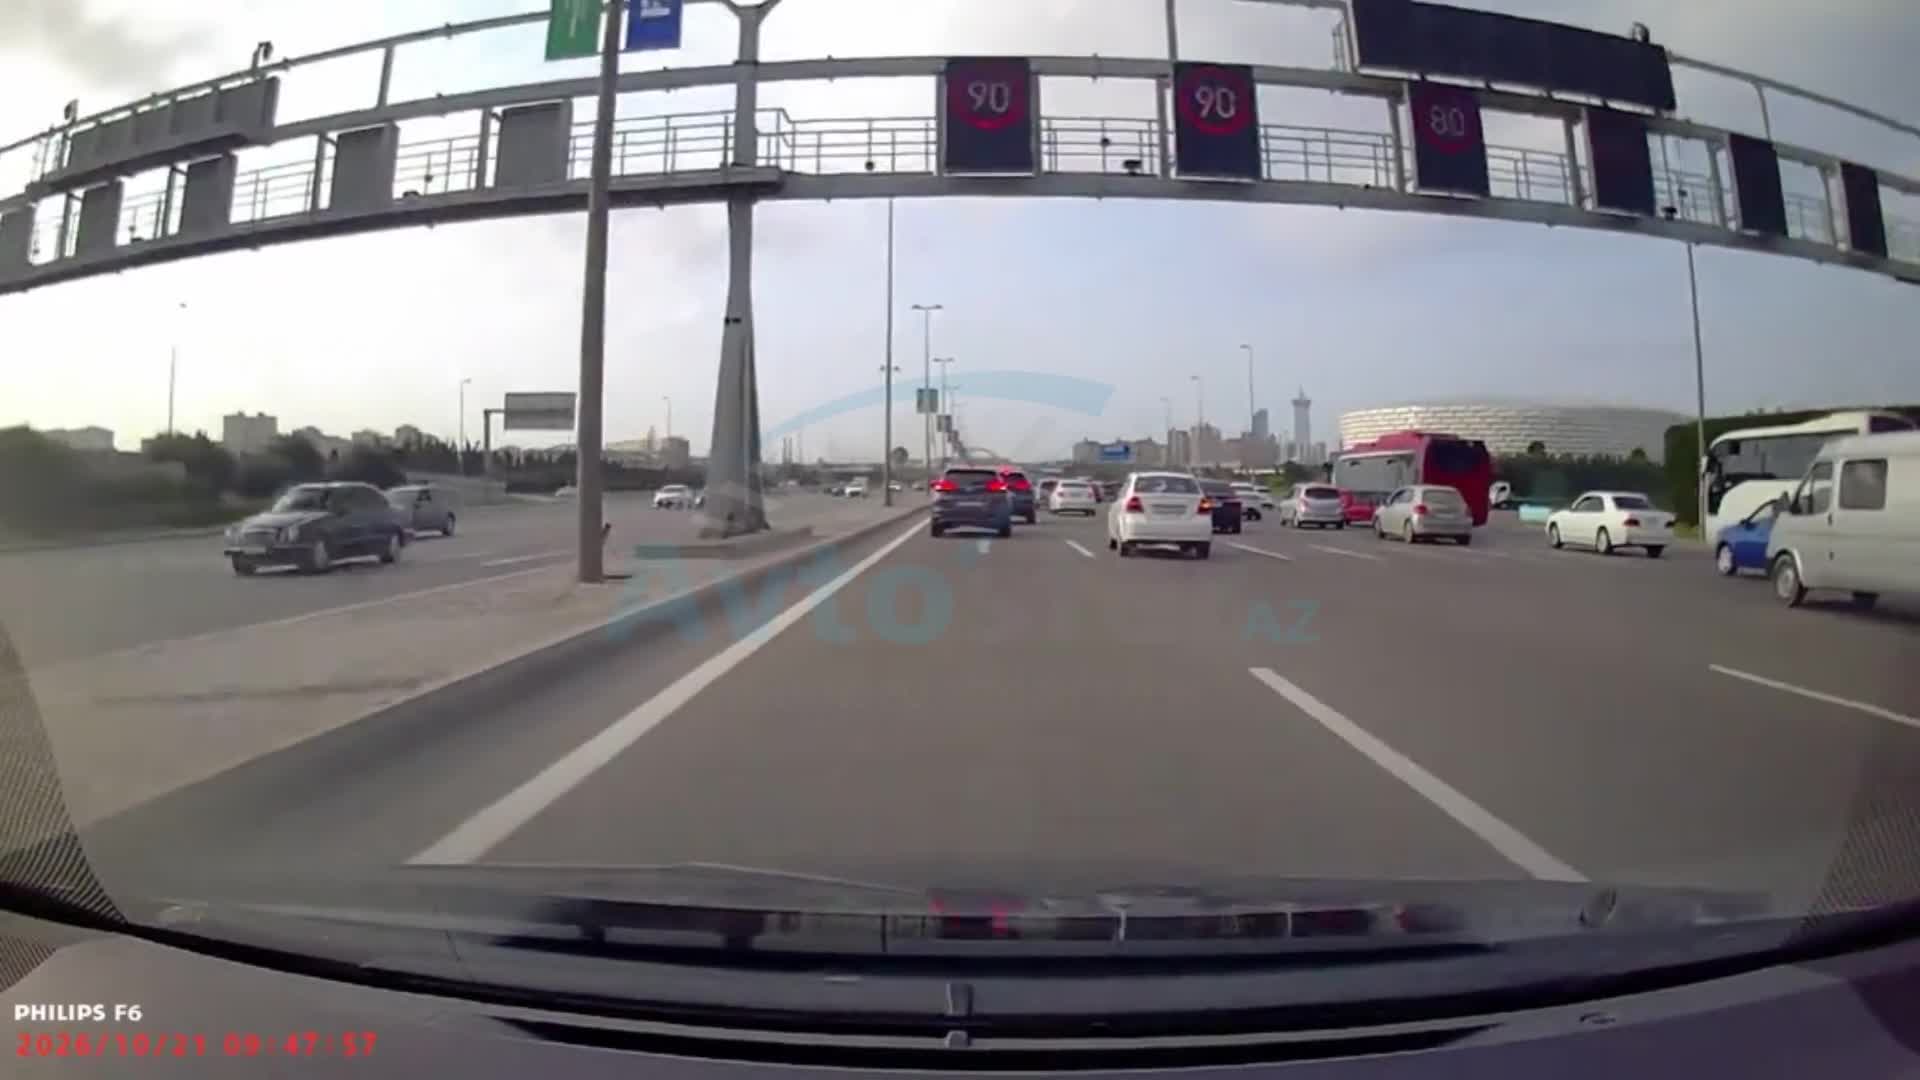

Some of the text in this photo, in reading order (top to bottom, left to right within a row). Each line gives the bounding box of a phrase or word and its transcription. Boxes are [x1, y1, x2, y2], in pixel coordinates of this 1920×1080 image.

[967, 80, 1009, 112] 90
[1195, 86, 1236, 118] 90
[1429, 104, 1465, 136] 80
